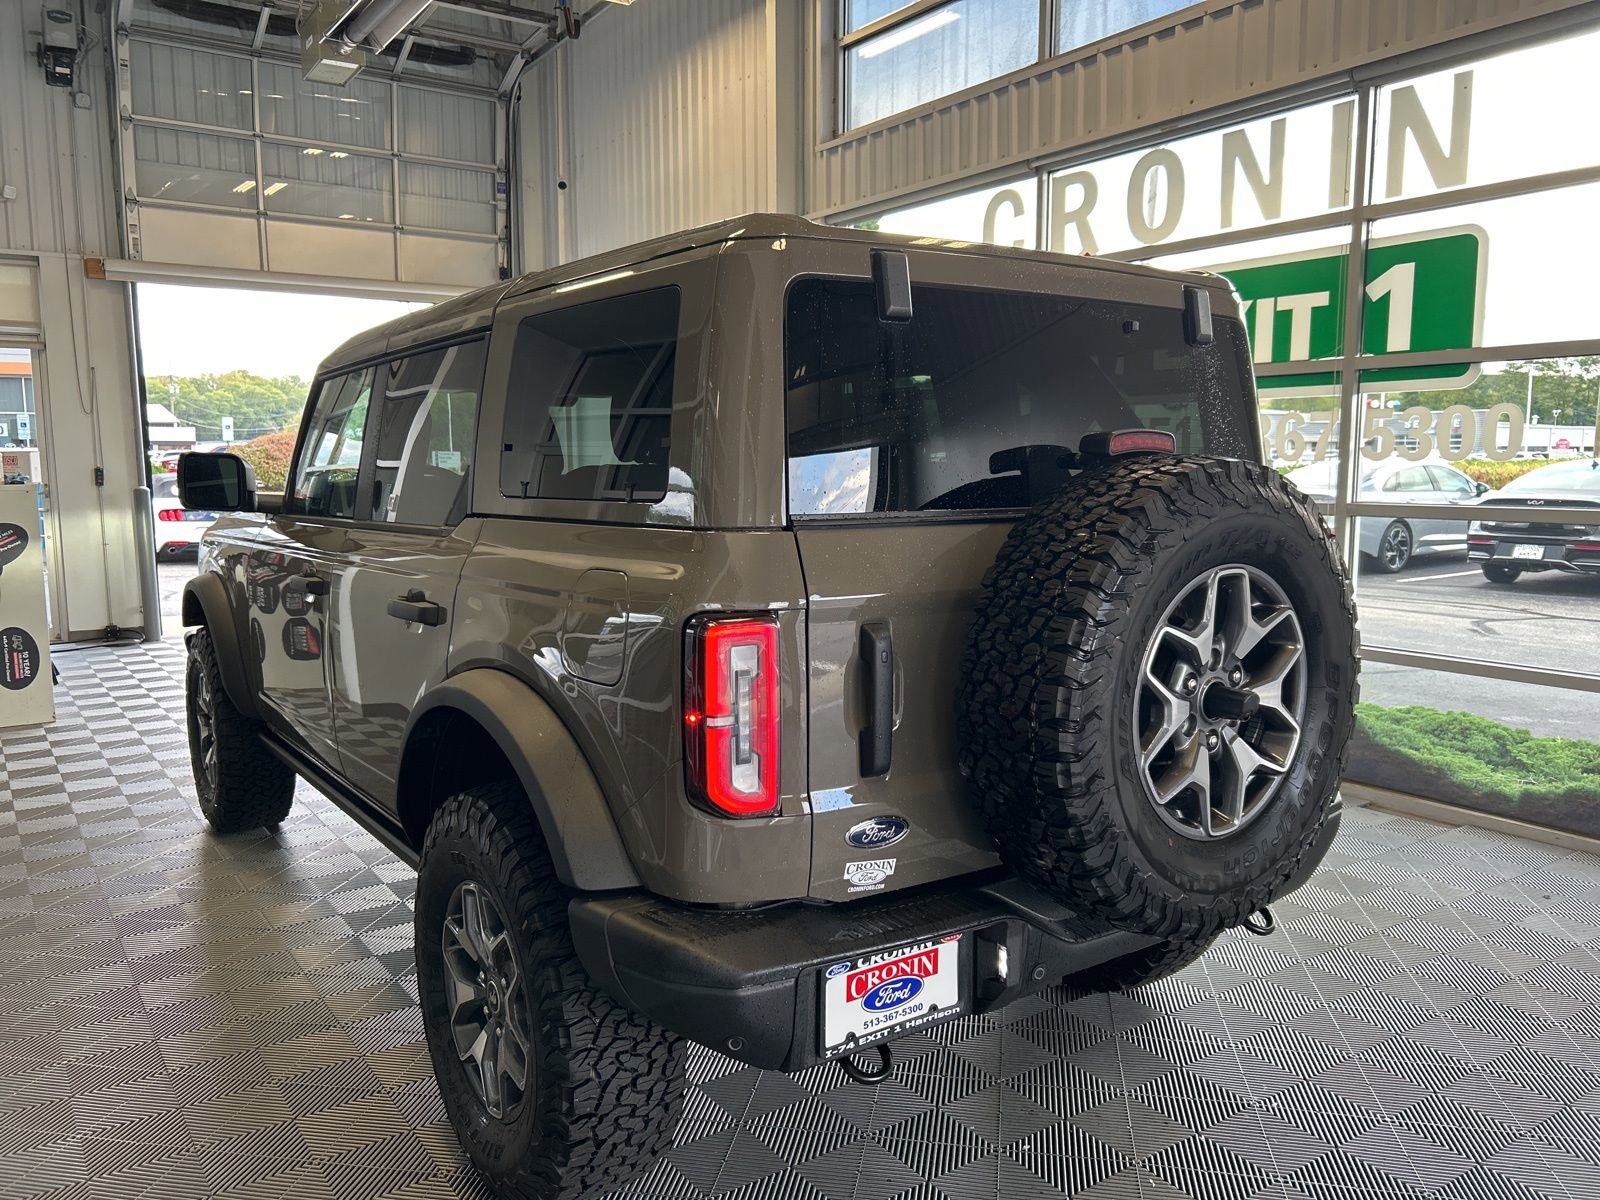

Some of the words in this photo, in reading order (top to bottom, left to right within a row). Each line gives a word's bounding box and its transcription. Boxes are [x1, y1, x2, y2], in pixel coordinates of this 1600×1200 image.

[983, 70, 1474, 256] CRONIN
[1244, 291, 1330, 364] IT
[1365, 262, 1416, 352] 1
[1360, 403, 1526, 463] 5300
[862, 824, 896, 843] Ford
[846, 860, 895, 875] CRONIN
[858, 871, 879, 882] Ford
[850, 952, 935, 999] CRONIN
[875, 981, 912, 1008] Ford
[825, 1040, 856, 1059] I-74
[859, 1027, 892, 1044] EXIT
[906, 1006, 961, 1029] Harrison
[863, 1002, 924, 1030] 513-367-5300
